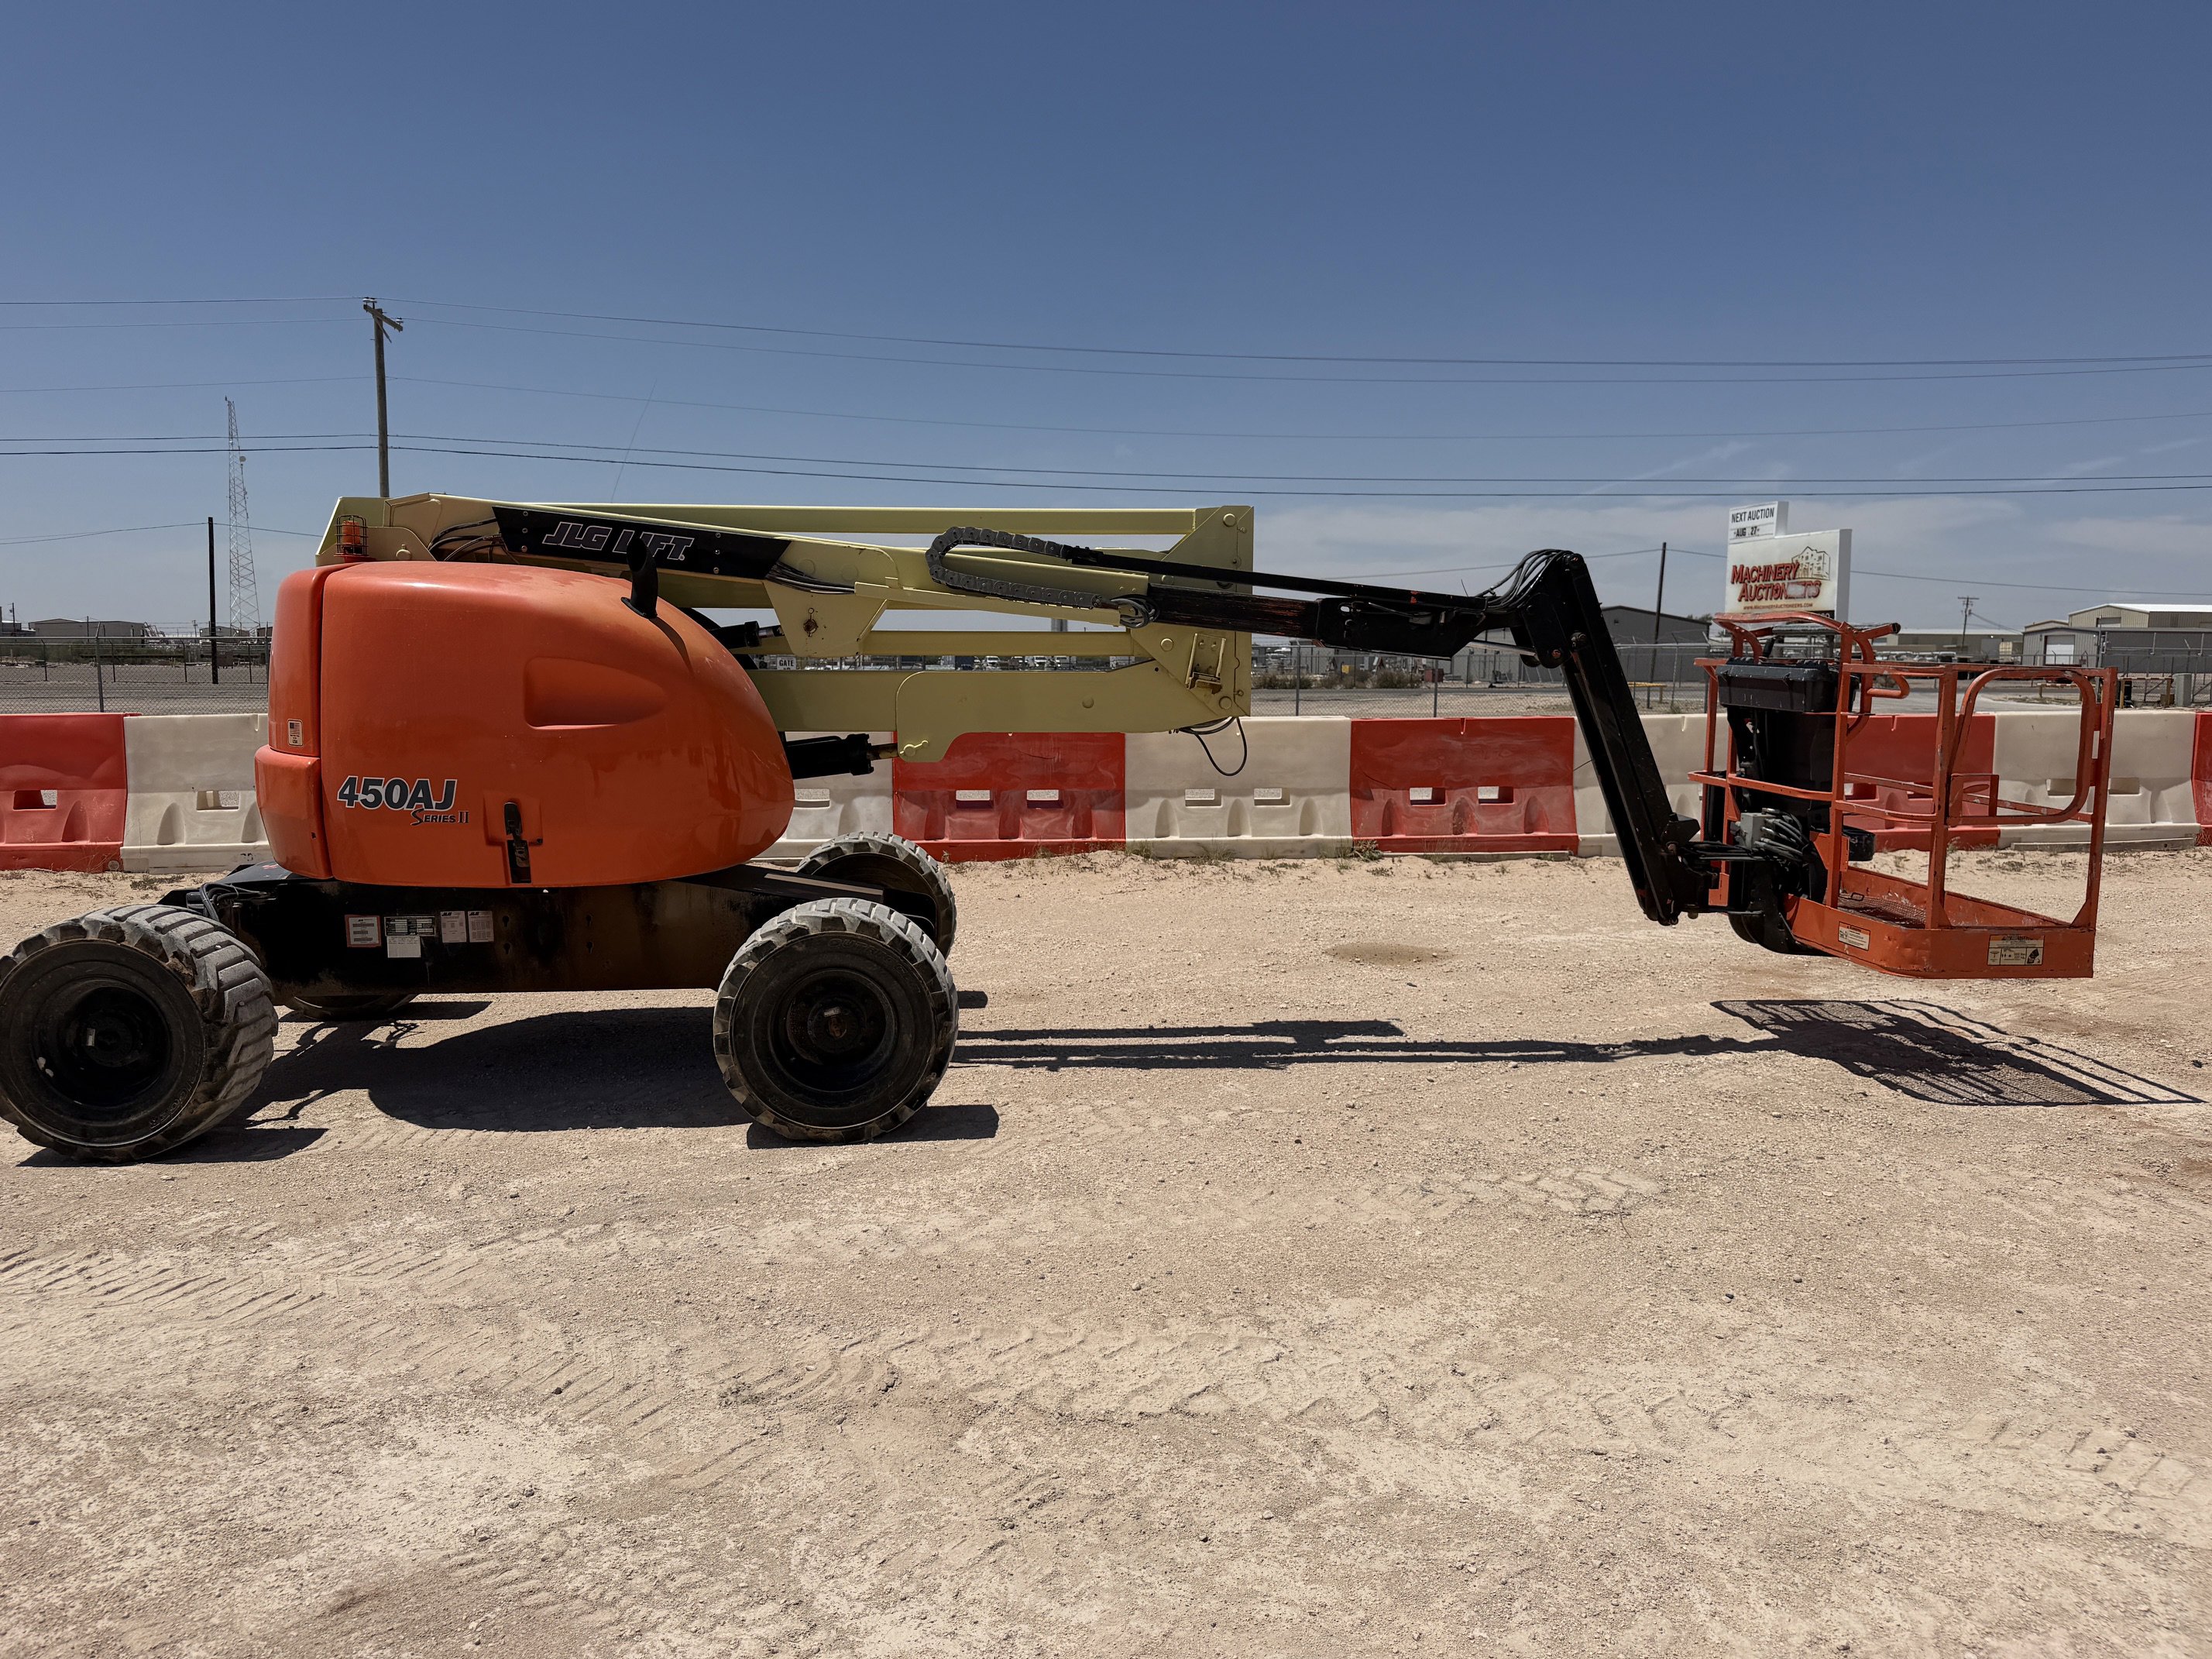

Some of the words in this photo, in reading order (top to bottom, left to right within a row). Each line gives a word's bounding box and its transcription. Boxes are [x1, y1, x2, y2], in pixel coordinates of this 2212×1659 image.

[1731, 511, 1747, 524] NEXT
[1747, 507, 1774, 521] AUCTION
[541, 521, 613, 551] JLG
[1730, 560, 1800, 584] MACHINERY
[1737, 580, 1822, 602] AUCTIONRS
[337, 775, 458, 812] 450AJ
[457, 810, 469, 824] II
